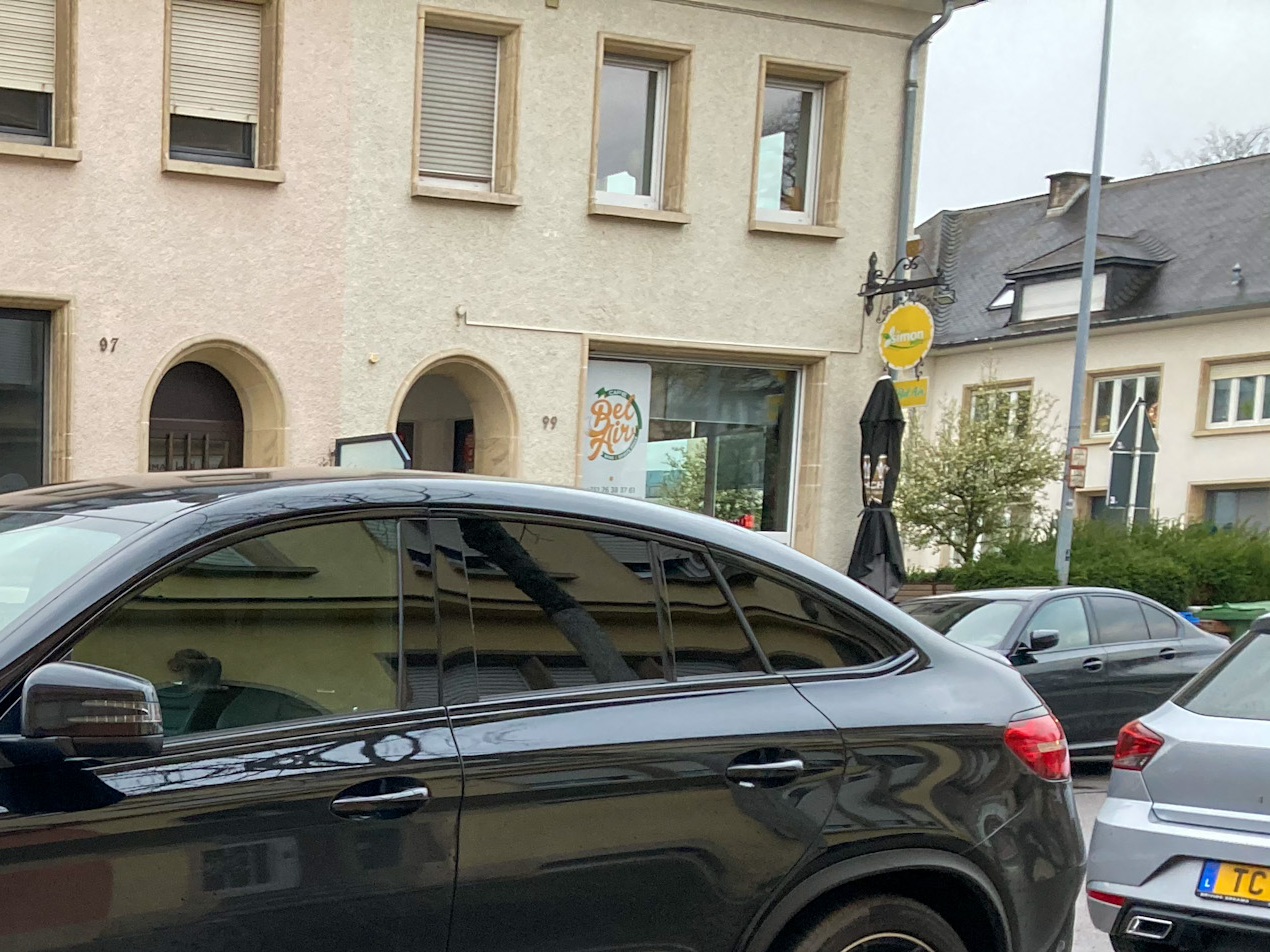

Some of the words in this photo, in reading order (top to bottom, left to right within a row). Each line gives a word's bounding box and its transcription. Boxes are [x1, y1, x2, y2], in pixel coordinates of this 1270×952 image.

[99, 337, 119, 353] 97
[542, 416, 558, 430] 99
[588, 394, 635, 437] Bel
[587, 421, 636, 461] Air
[1204, 878, 1211, 888] L
[1234, 867, 1266, 895] TC
